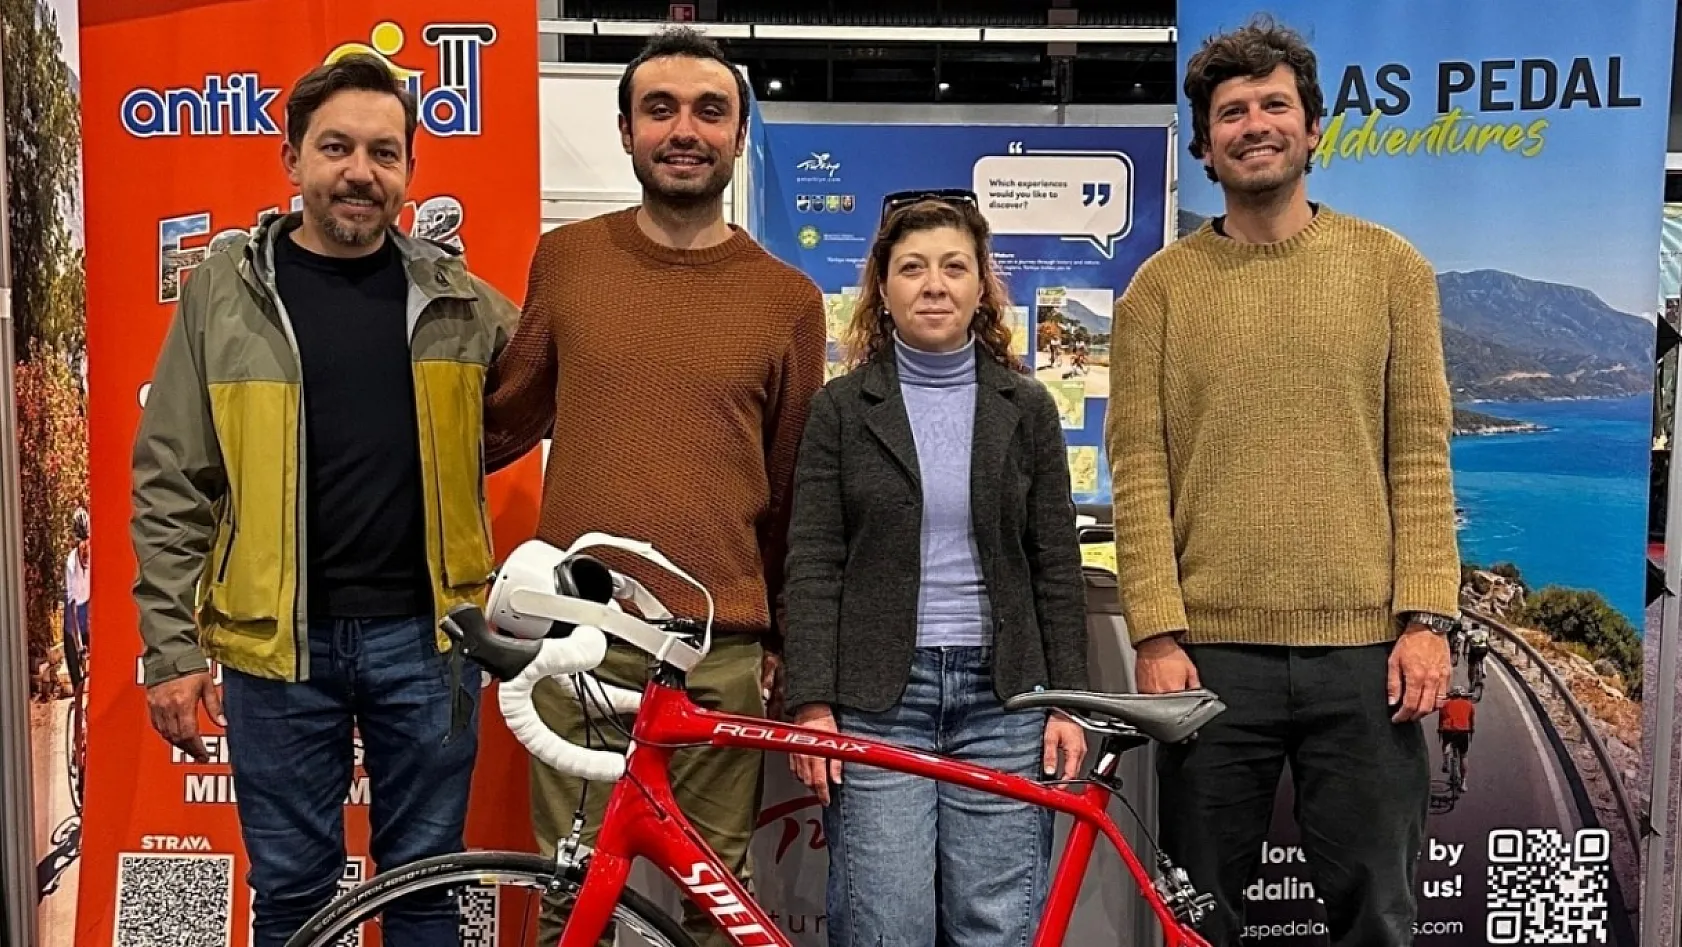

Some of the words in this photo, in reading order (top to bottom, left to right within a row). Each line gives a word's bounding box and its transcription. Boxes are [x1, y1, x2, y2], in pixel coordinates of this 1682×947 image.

[1320, 64, 1411, 116] AS
[1438, 56, 1641, 113] PEDAL
[121, 73, 282, 136] antik
[1311, 107, 1549, 168] Adventures
[989, 179, 1015, 187] Which
[1017, 179, 1068, 189] experiences
[989, 190, 1014, 198] would
[1015, 192, 1031, 200] you
[1032, 190, 1047, 198] like
[989, 201, 1029, 209] discover?
[713, 722, 871, 753] ROUBAIX
[141, 836, 211, 850] STRAVA
[1429, 838, 1464, 867] by
[1243, 877, 1325, 904] dalin
[1423, 874, 1462, 898] us!
[670, 862, 780, 947] SPEC
